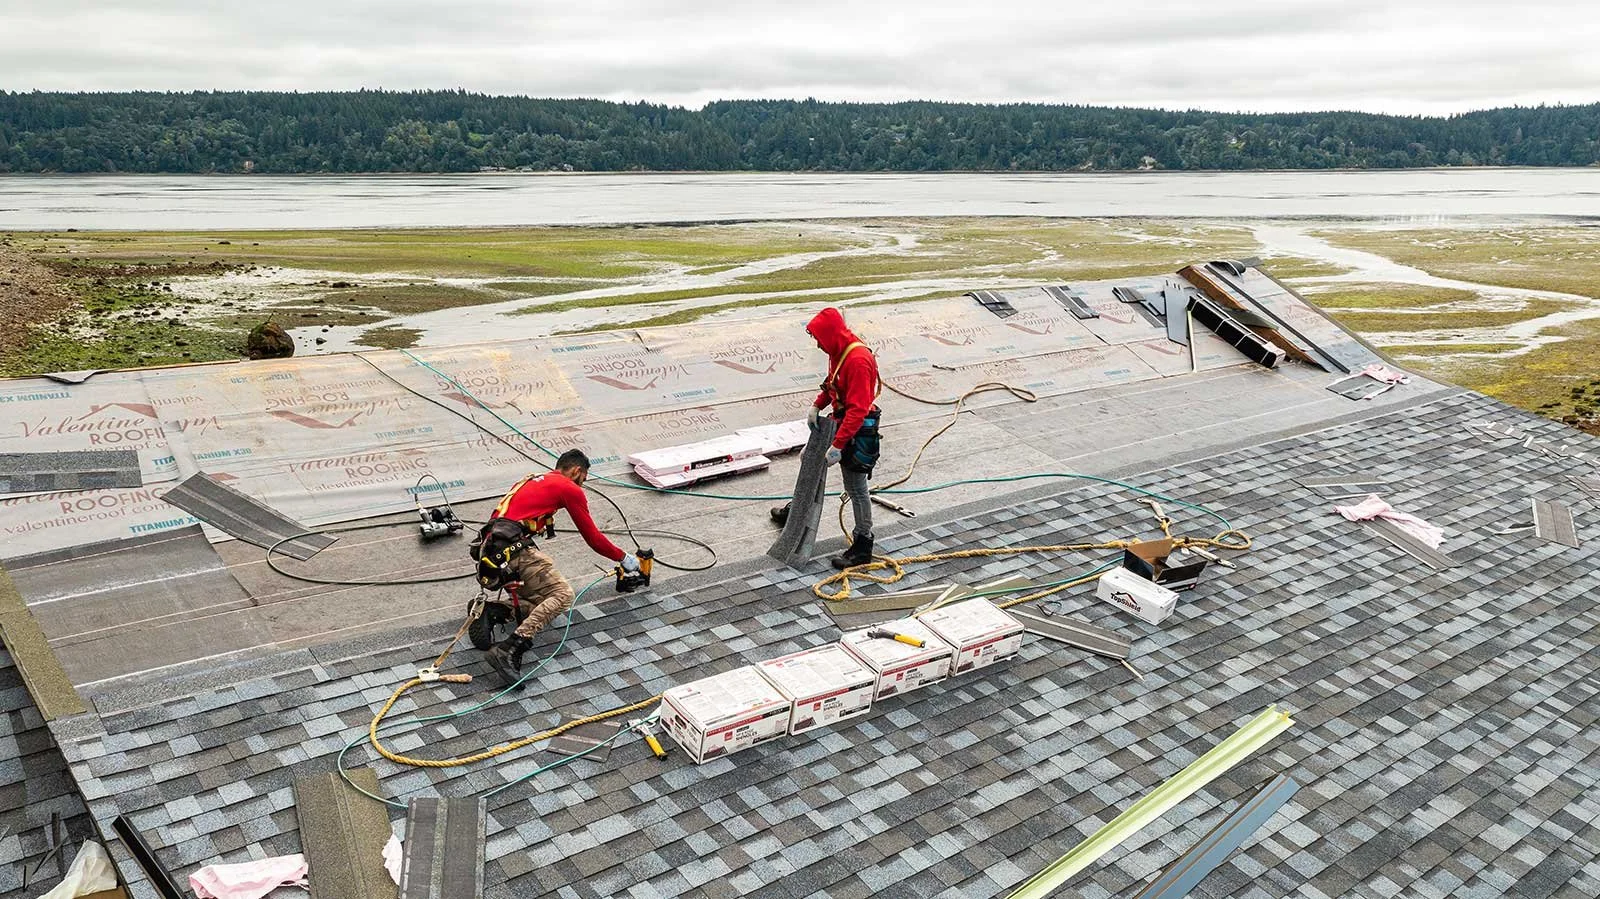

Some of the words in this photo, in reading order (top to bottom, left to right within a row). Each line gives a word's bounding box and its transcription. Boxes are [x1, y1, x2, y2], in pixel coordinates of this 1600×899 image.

[738, 350, 804, 365] Valentine
[583, 358, 645, 375] ROOFING
[616, 363, 691, 381] Valentine
[17, 391, 72, 402] TITANIUM
[266, 391, 350, 408] ROOFING
[306, 397, 404, 418] Valentine
[19, 415, 145, 438] Valentine
[659, 413, 719, 431] ROOFING
[233, 447, 252, 457] X30
[516, 433, 585, 454] ROOFING
[345, 457, 428, 478] ROOFING
[404, 482, 447, 495] TITANIUM
[448, 479, 465, 489] X30
[128, 518, 185, 534] TITANIUM
[1110, 592, 1142, 613] TopShield
